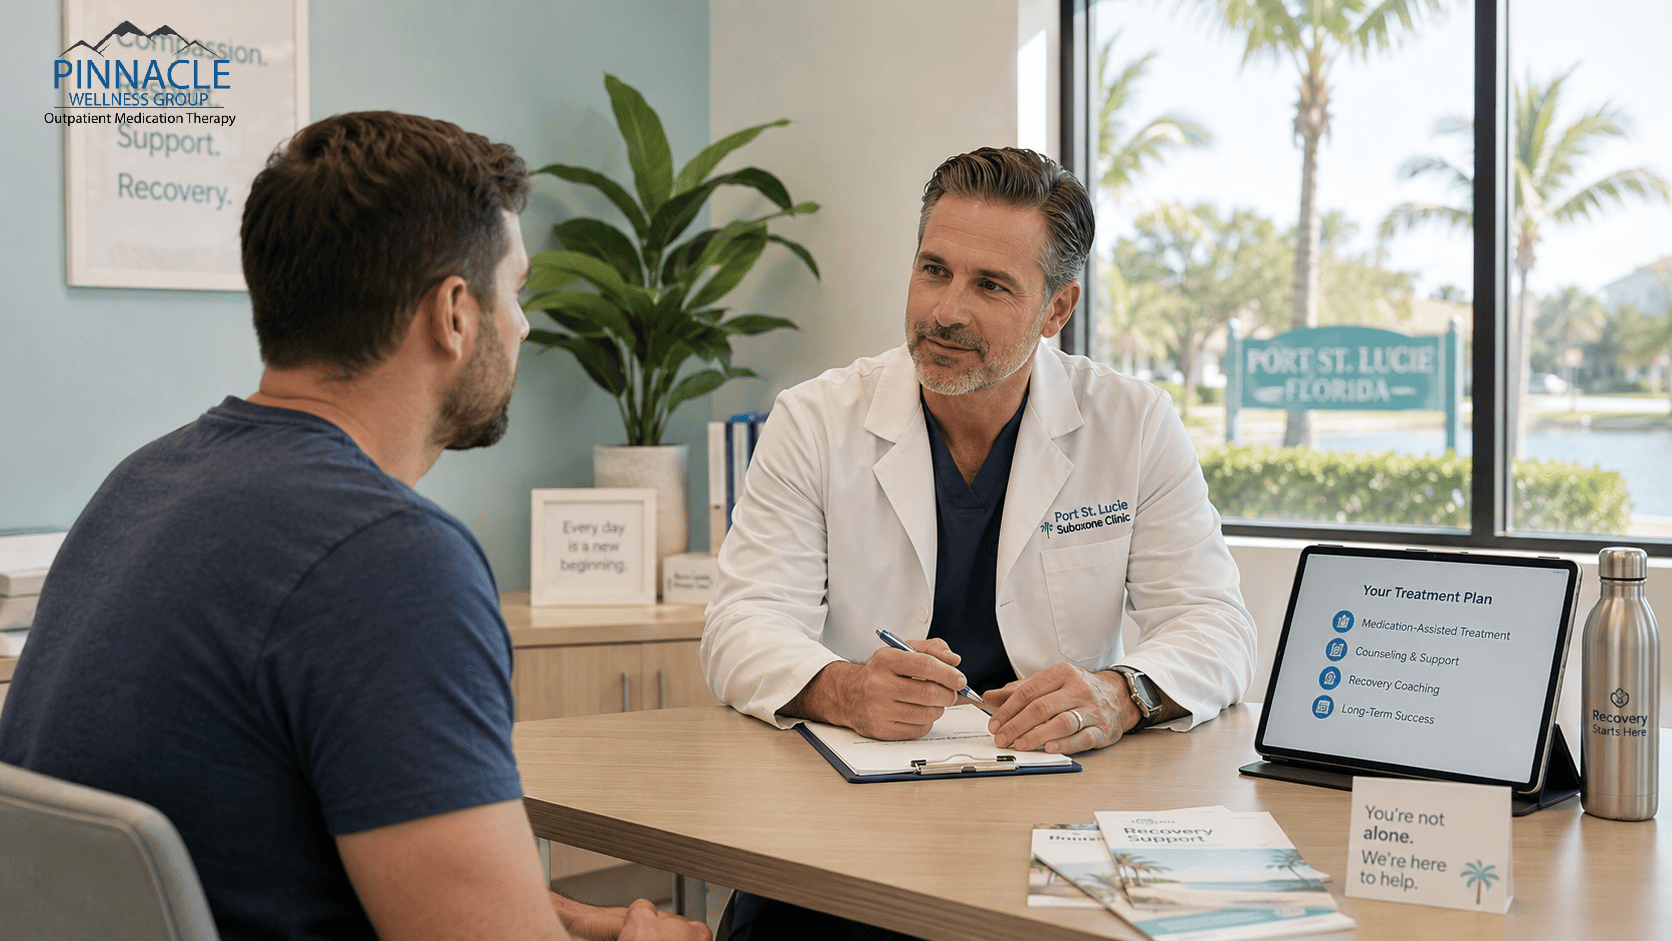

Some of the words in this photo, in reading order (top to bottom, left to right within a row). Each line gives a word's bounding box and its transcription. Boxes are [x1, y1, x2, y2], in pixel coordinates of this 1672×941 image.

[116, 31, 268, 67] Compassion.
[117, 123, 220, 158] Support.
[118, 172, 232, 211] Recovery.
[1247, 346, 1314, 375] PORT
[1316, 346, 1354, 375] ST.
[1359, 345, 1436, 375] LUCIE
[1285, 378, 1391, 403] FLORIDA
[1054, 508, 1079, 523] Port
[1080, 506, 1097, 518] St.
[1098, 500, 1129, 515] Lucie
[563, 519, 599, 538] Every
[601, 519, 626, 538] day
[1056, 519, 1103, 535] Suboxone
[1104, 512, 1131, 526] Clinic
[567, 538, 578, 553] is
[581, 541, 589, 553] a
[592, 541, 620, 553] new
[560, 557, 629, 575] beginning.
[1363, 584, 1392, 598] Your
[1395, 586, 1460, 603] Treatment
[1463, 591, 1493, 605] Plan
[1361, 618, 1458, 636] Medication-Assisted
[1460, 626, 1511, 641] Treatment
[1355, 646, 1407, 663] Counseling
[1409, 651, 1417, 662] &
[1419, 652, 1460, 666] Support
[1348, 674, 1392, 691] Recovery
[1394, 680, 1440, 697] Coaching
[1341, 704, 1393, 719] Long-Term
[1395, 710, 1435, 725] Success
[1592, 709, 1648, 727] Recovery
[1592, 723, 1621, 736] Starts
[1623, 727, 1647, 737] Here
[1365, 804, 1414, 824] You're
[1418, 813, 1445, 827] not
[1123, 827, 1213, 836] Recovery
[1128, 834, 1206, 844] Support
[1363, 825, 1414, 844] alone.
[1361, 849, 1406, 868] We're
[1410, 854, 1447, 873] here
[1360, 870, 1376, 885] to
[1380, 871, 1418, 892] help.
